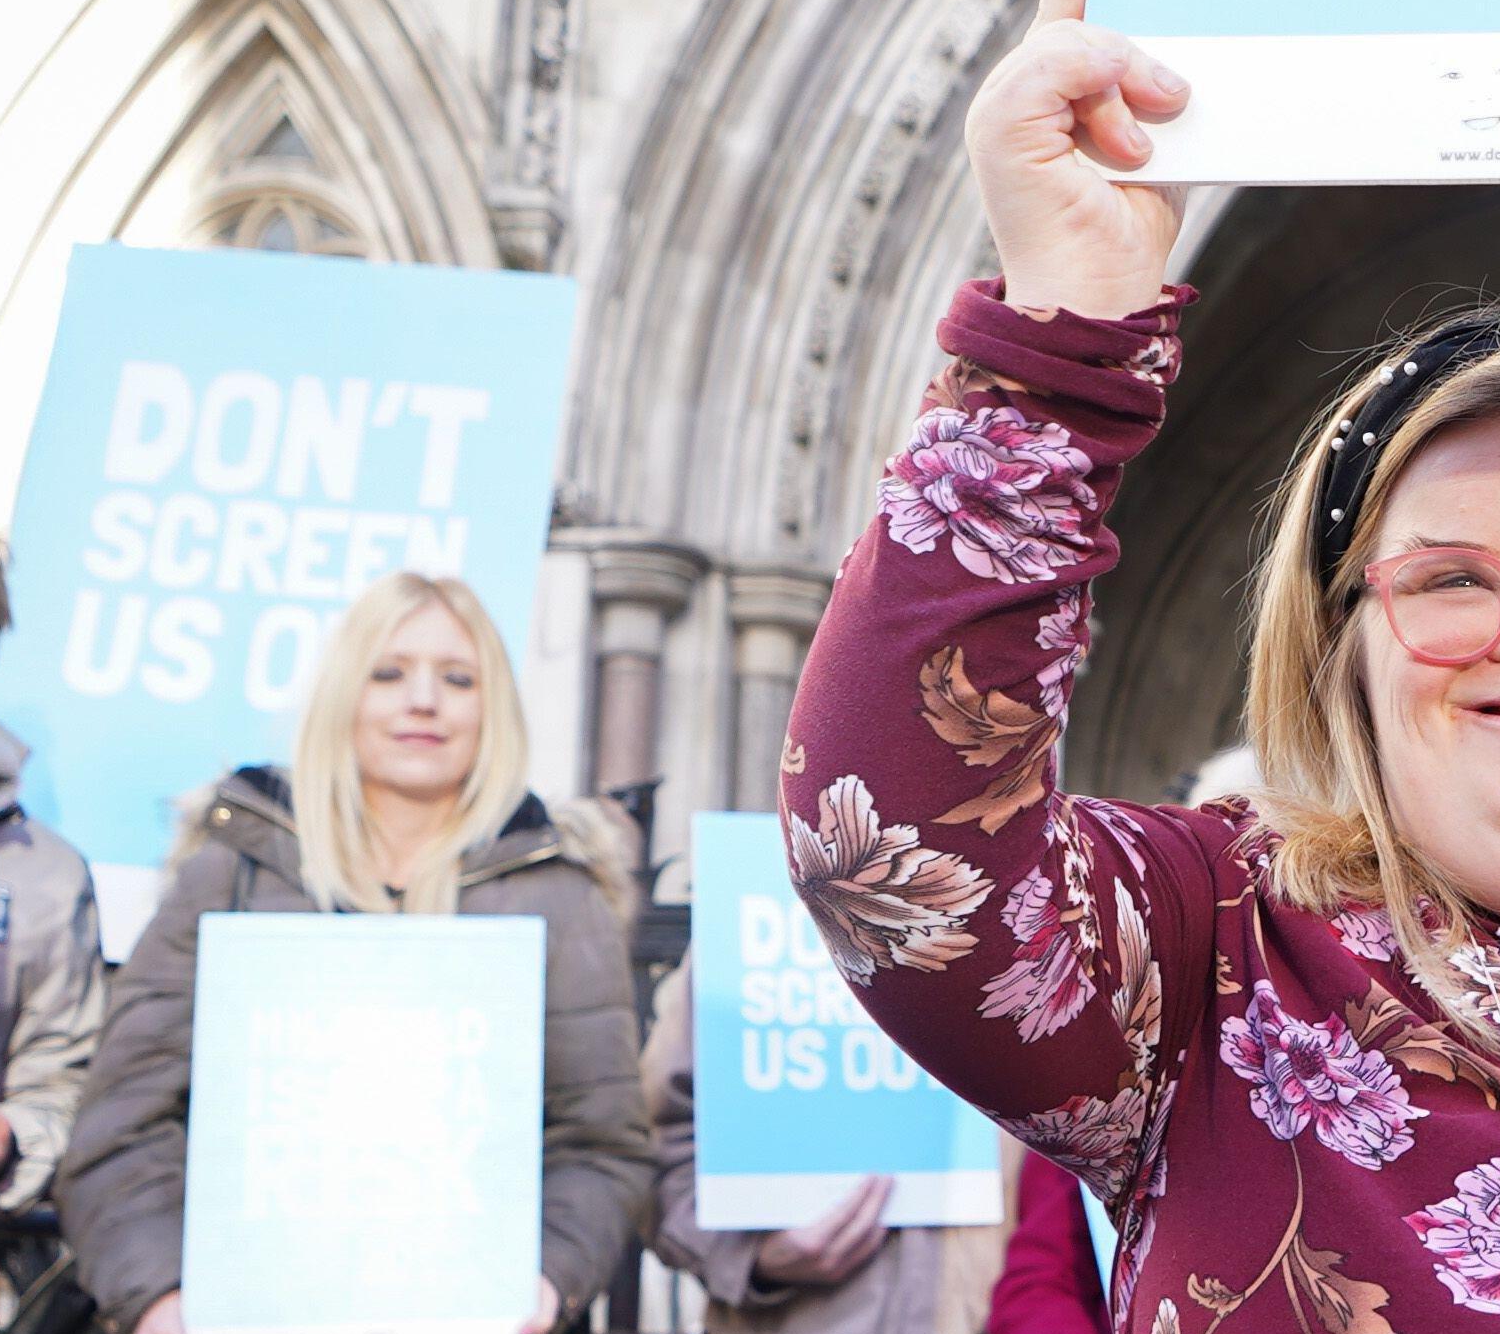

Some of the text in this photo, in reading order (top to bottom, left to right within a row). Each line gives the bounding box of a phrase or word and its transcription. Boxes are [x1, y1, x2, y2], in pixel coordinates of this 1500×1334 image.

[103, 359, 491, 509] DON'T
[61, 587, 225, 704] US
[742, 1028, 944, 1092] US OU
